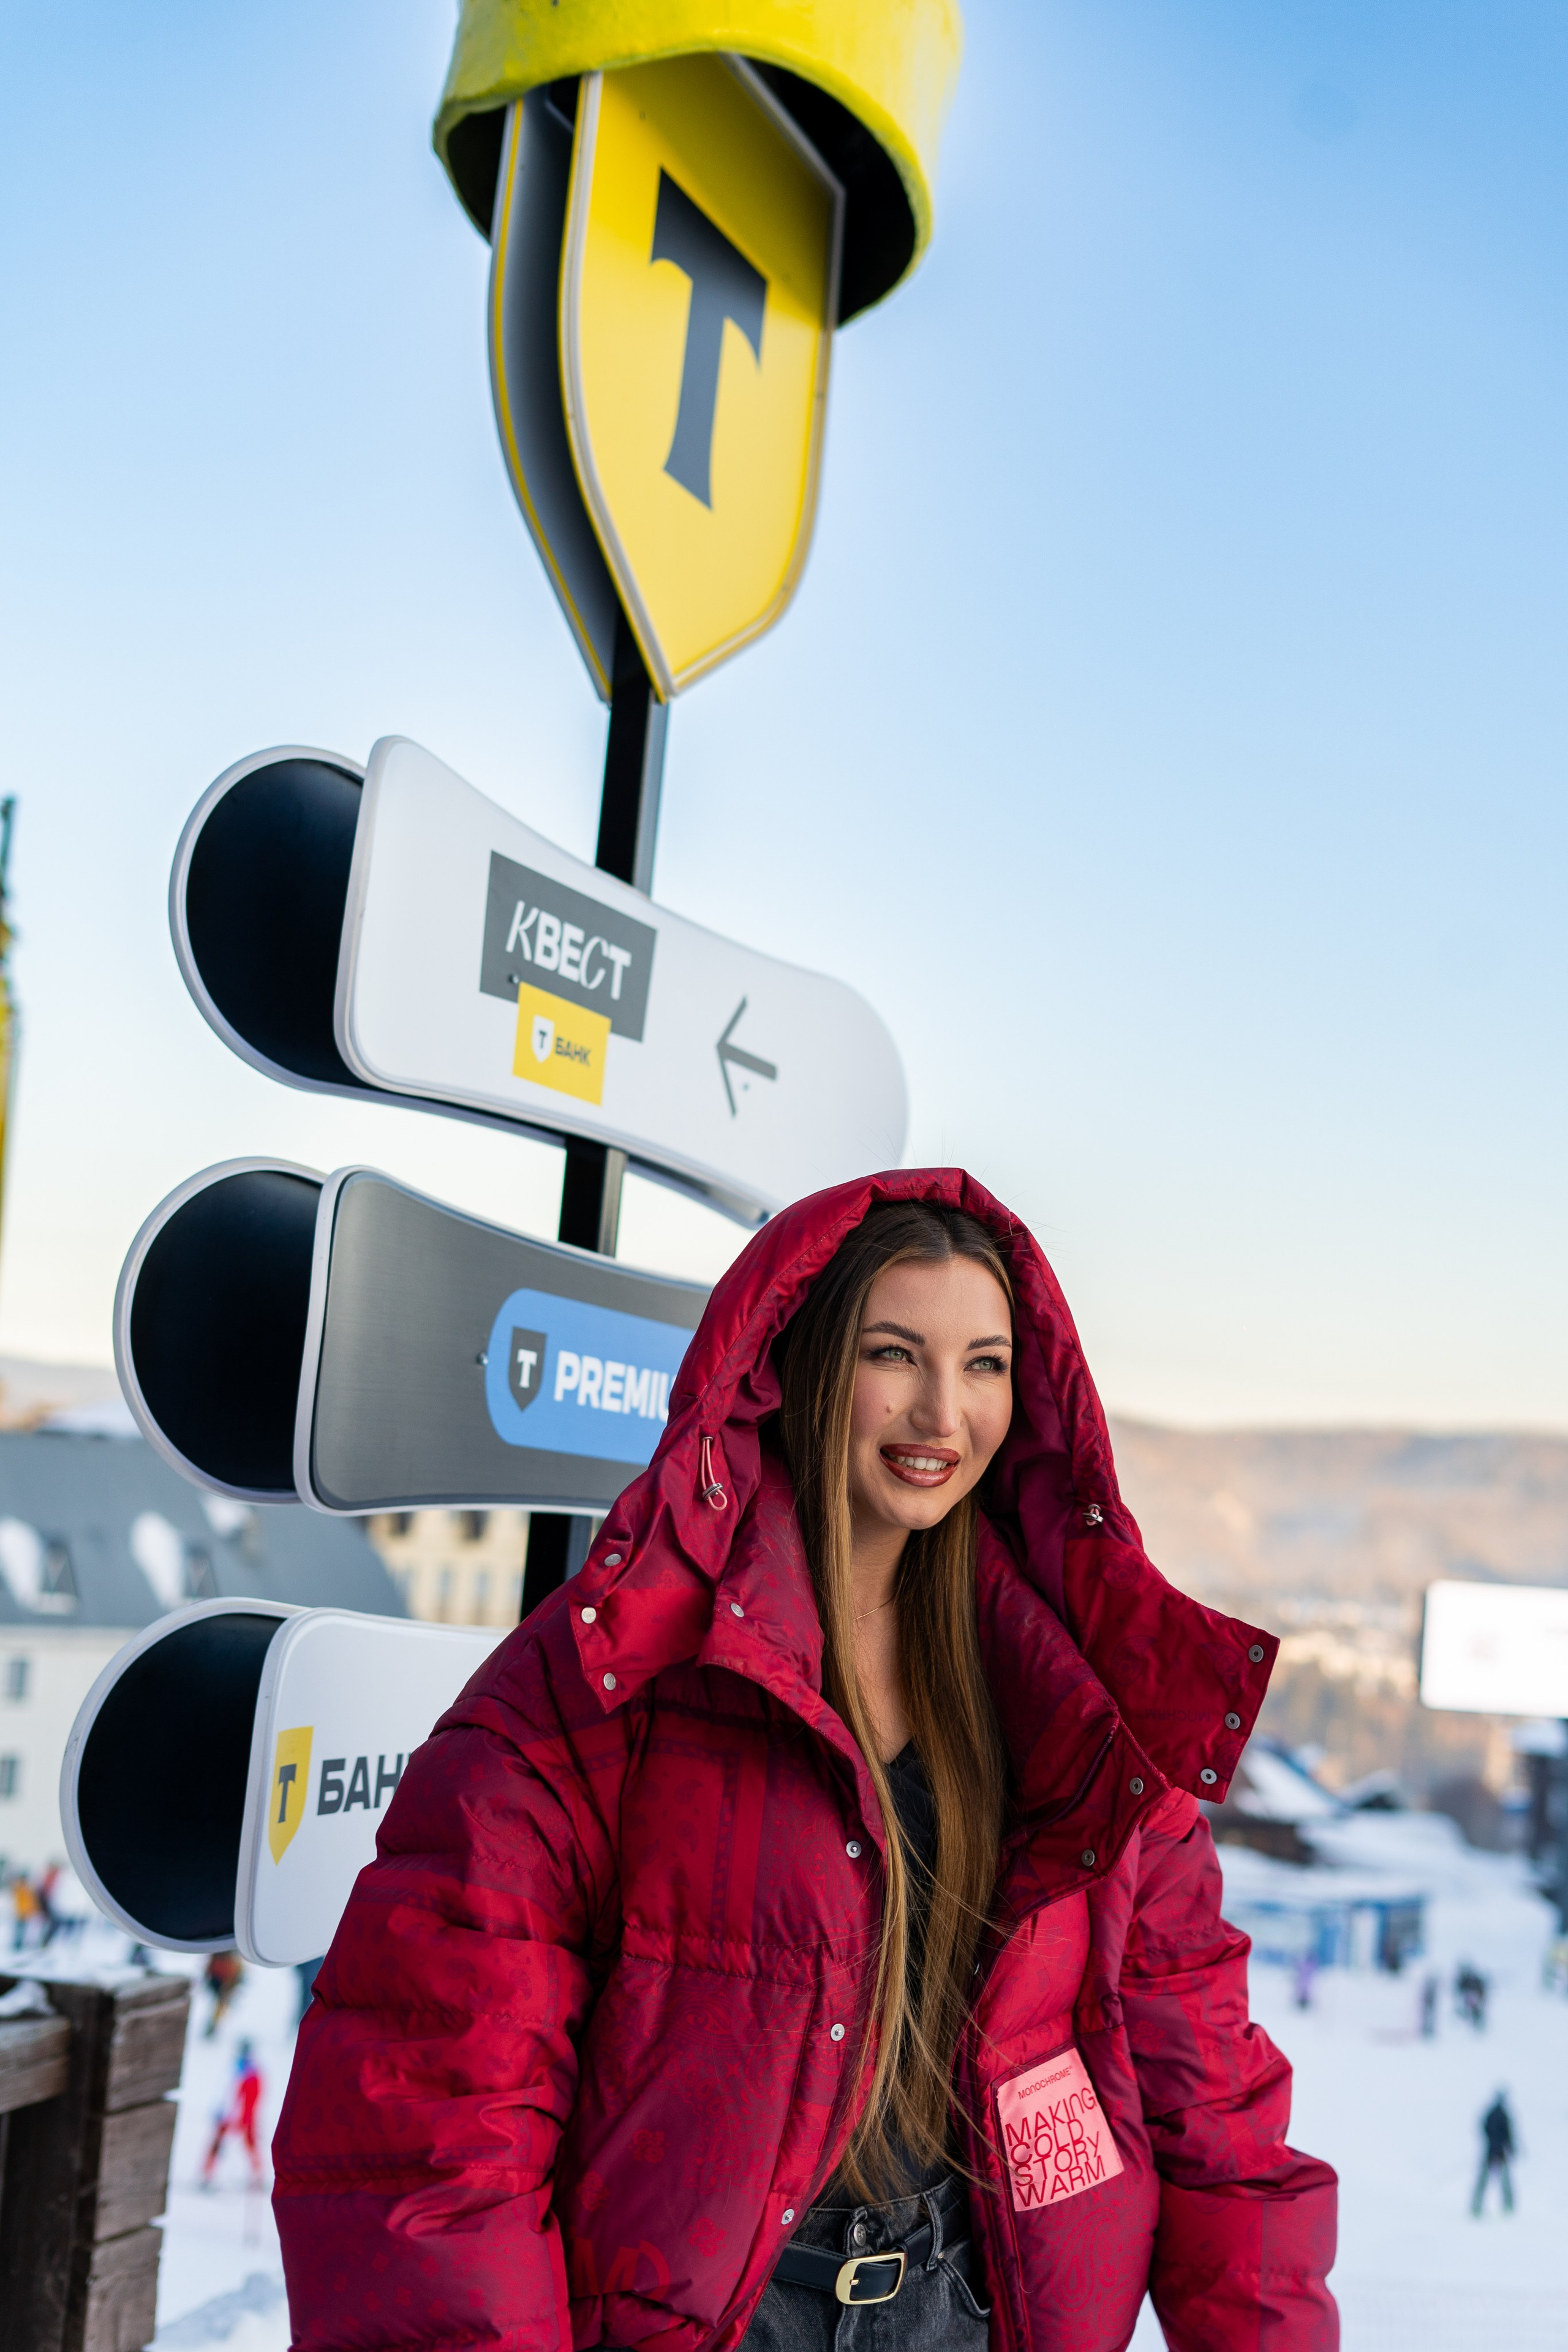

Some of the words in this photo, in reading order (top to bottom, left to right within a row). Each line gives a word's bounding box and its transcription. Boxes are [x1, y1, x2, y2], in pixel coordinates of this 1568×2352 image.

[505, 900, 632, 1001] КВЕСТ
[554, 1036, 592, 1068] БАНК
[317, 1752, 412, 1816] БАН
[1005, 2087, 1097, 2147] MAKING
[1011, 2118, 1084, 2165] COLD
[1014, 2130, 1100, 2187] STORY
[1016, 2155, 1106, 2207] WARM
